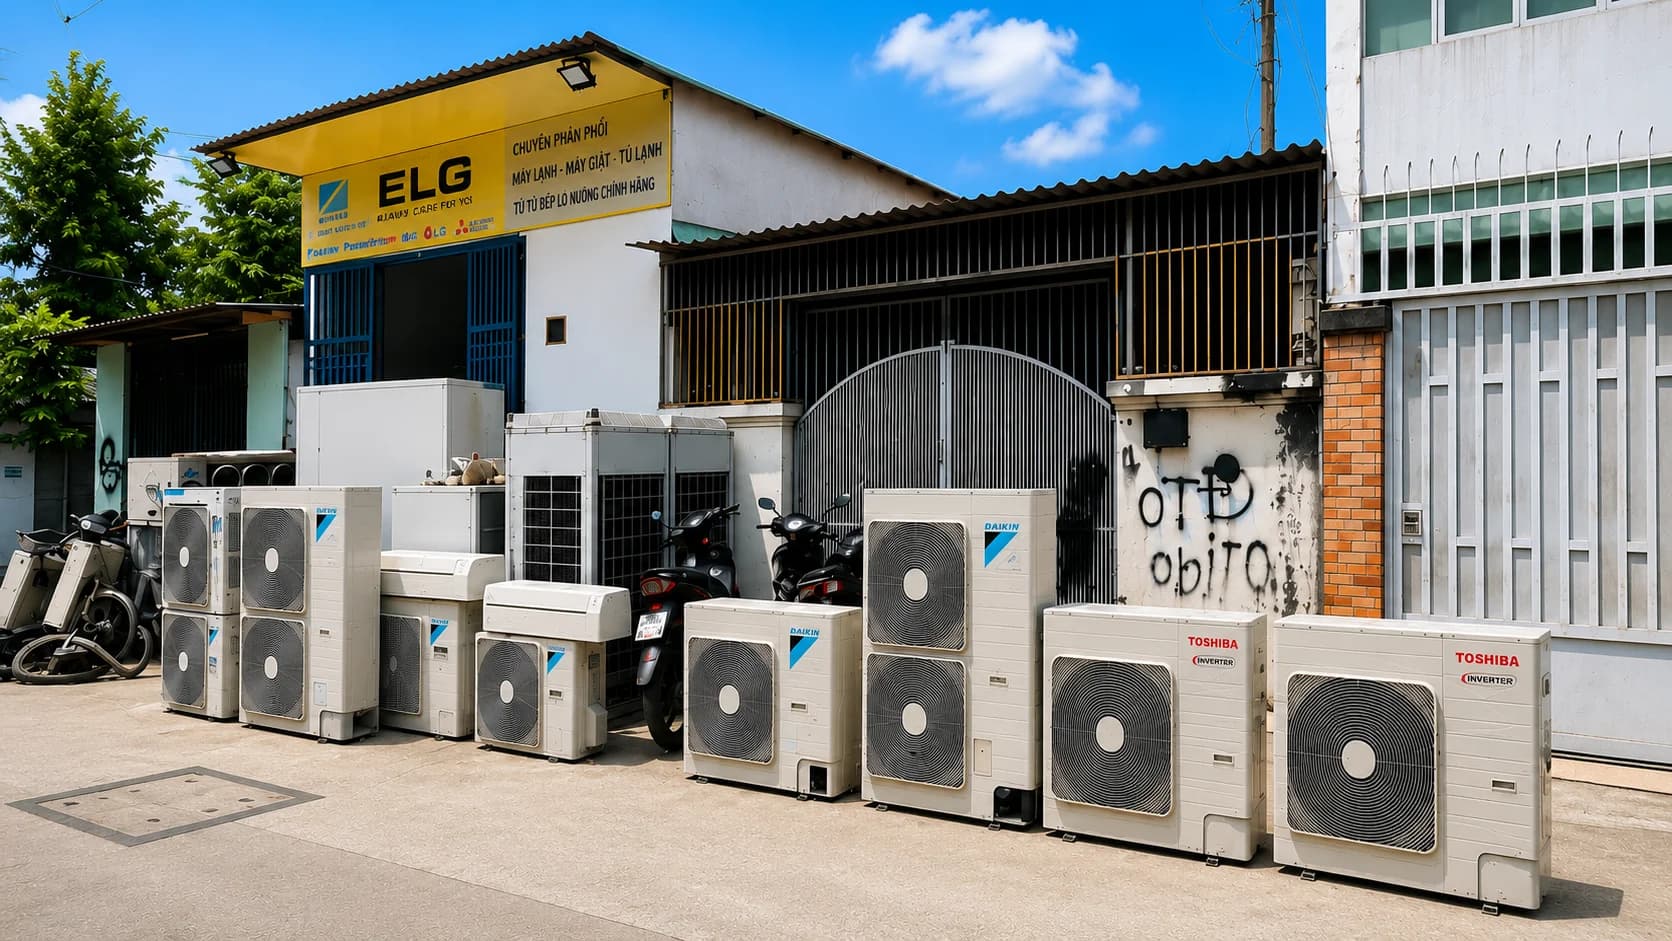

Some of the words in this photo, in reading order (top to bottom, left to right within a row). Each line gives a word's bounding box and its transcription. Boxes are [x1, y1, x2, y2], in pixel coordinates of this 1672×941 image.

[379, 155, 471, 209] ELG
[985, 522, 1019, 530] DAIKIN
[790, 627, 820, 636] DAIKIN
[1188, 636, 1239, 650] TOSHIBA
[1455, 652, 1520, 667] TOSHIBA
[1467, 675, 1513, 685] INVERTER
